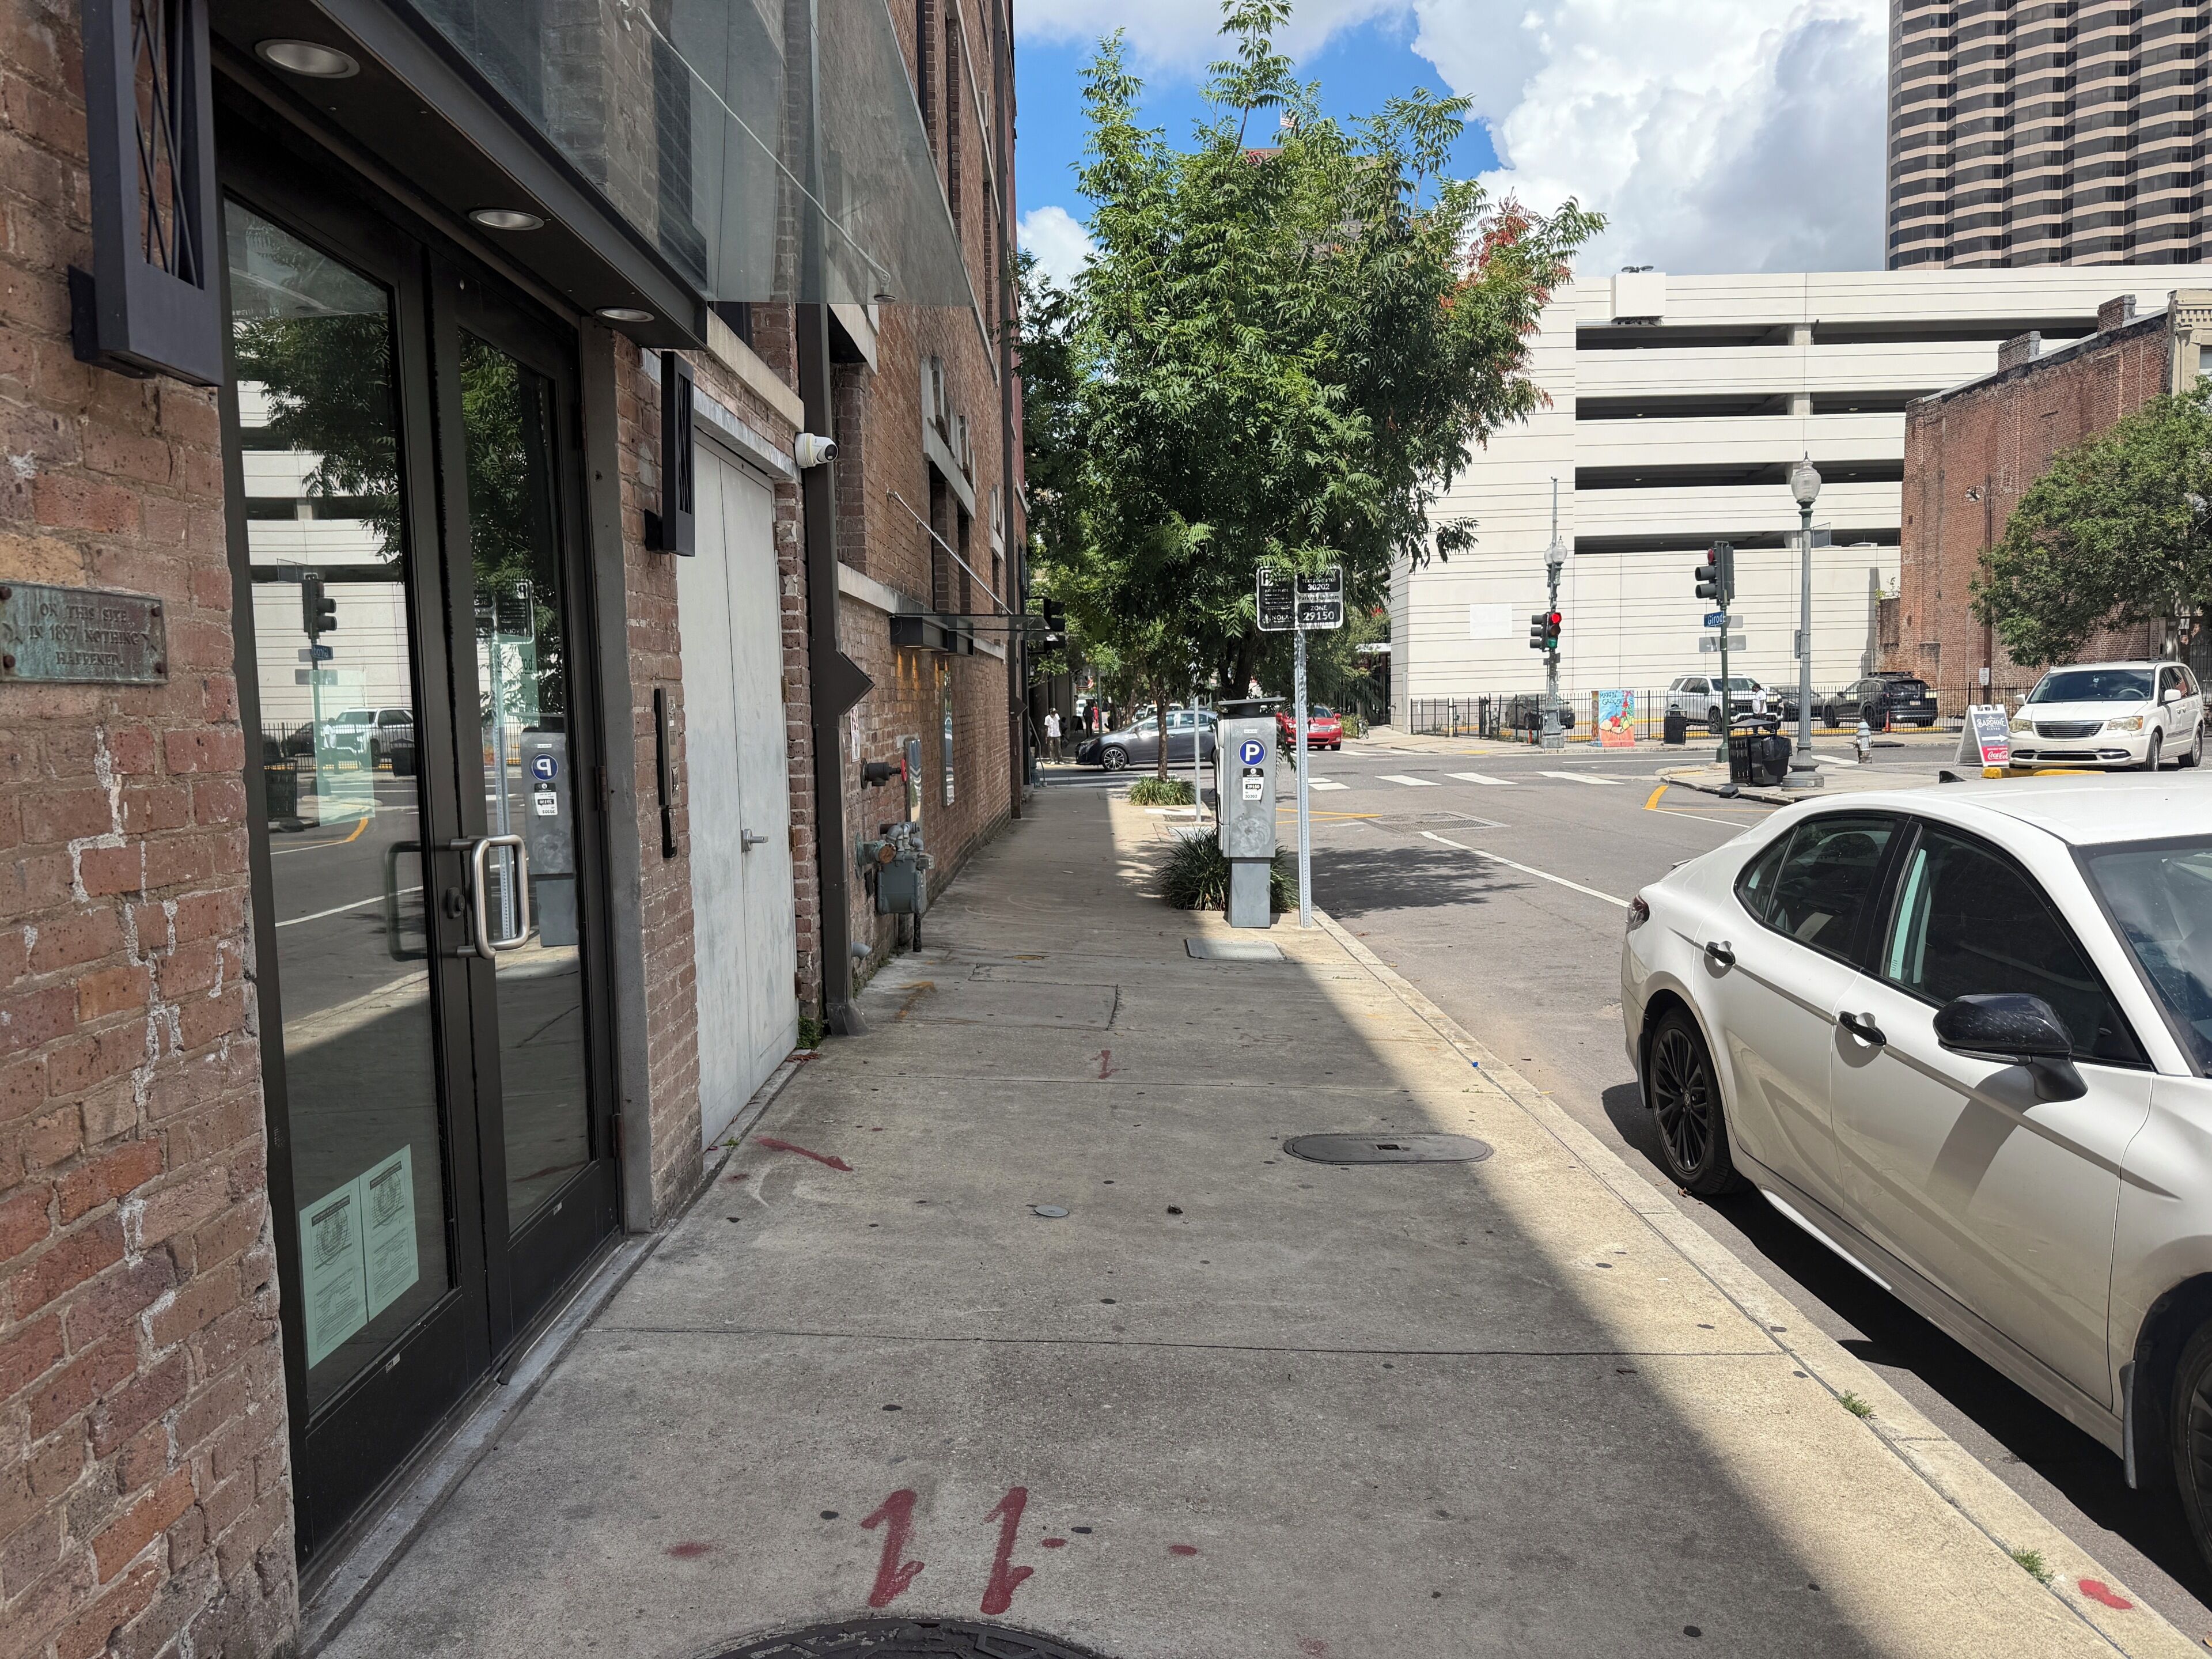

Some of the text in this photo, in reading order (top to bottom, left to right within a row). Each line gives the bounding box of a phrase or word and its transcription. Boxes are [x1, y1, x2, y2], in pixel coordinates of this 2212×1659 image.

[39, 603, 127, 622] ON THIS SITE
[1303, 611, 1335, 621] 29150
[1708, 613, 1722, 625] Girod
[28, 624, 139, 645] IN 1897 NOTHING
[1976, 718, 2006, 728] BARONNE
[1245, 744, 1260, 762] P
